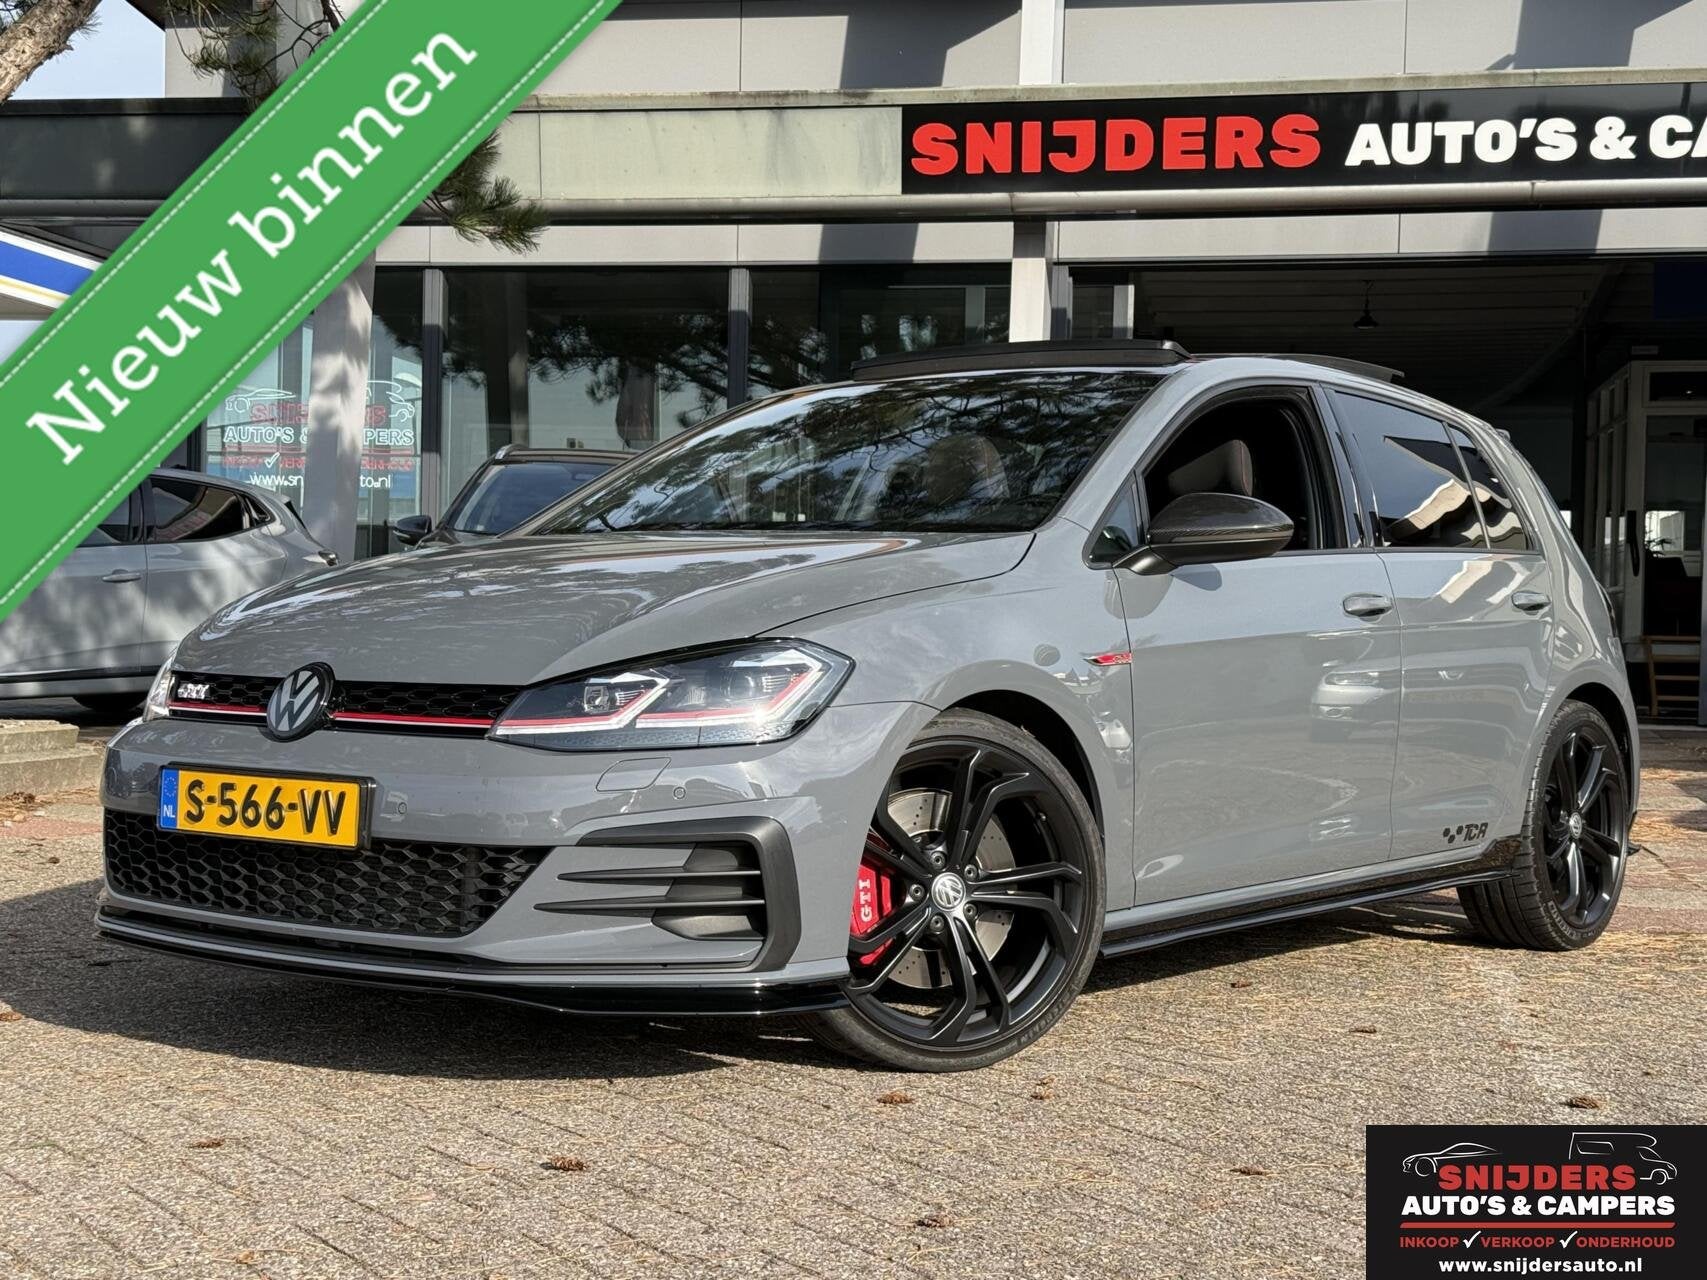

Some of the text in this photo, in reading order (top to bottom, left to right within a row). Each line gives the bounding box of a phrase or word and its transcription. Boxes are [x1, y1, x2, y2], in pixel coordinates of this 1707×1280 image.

[911, 114, 1321, 175] SNIJDERS
[1344, 117, 1578, 166] AUTO'S
[1589, 115, 1638, 161] &
[362, 428, 415, 446] PERS
[163, 805, 176, 818] NL
[184, 779, 347, 836] S-566-VV
[858, 879, 873, 922] GTI
